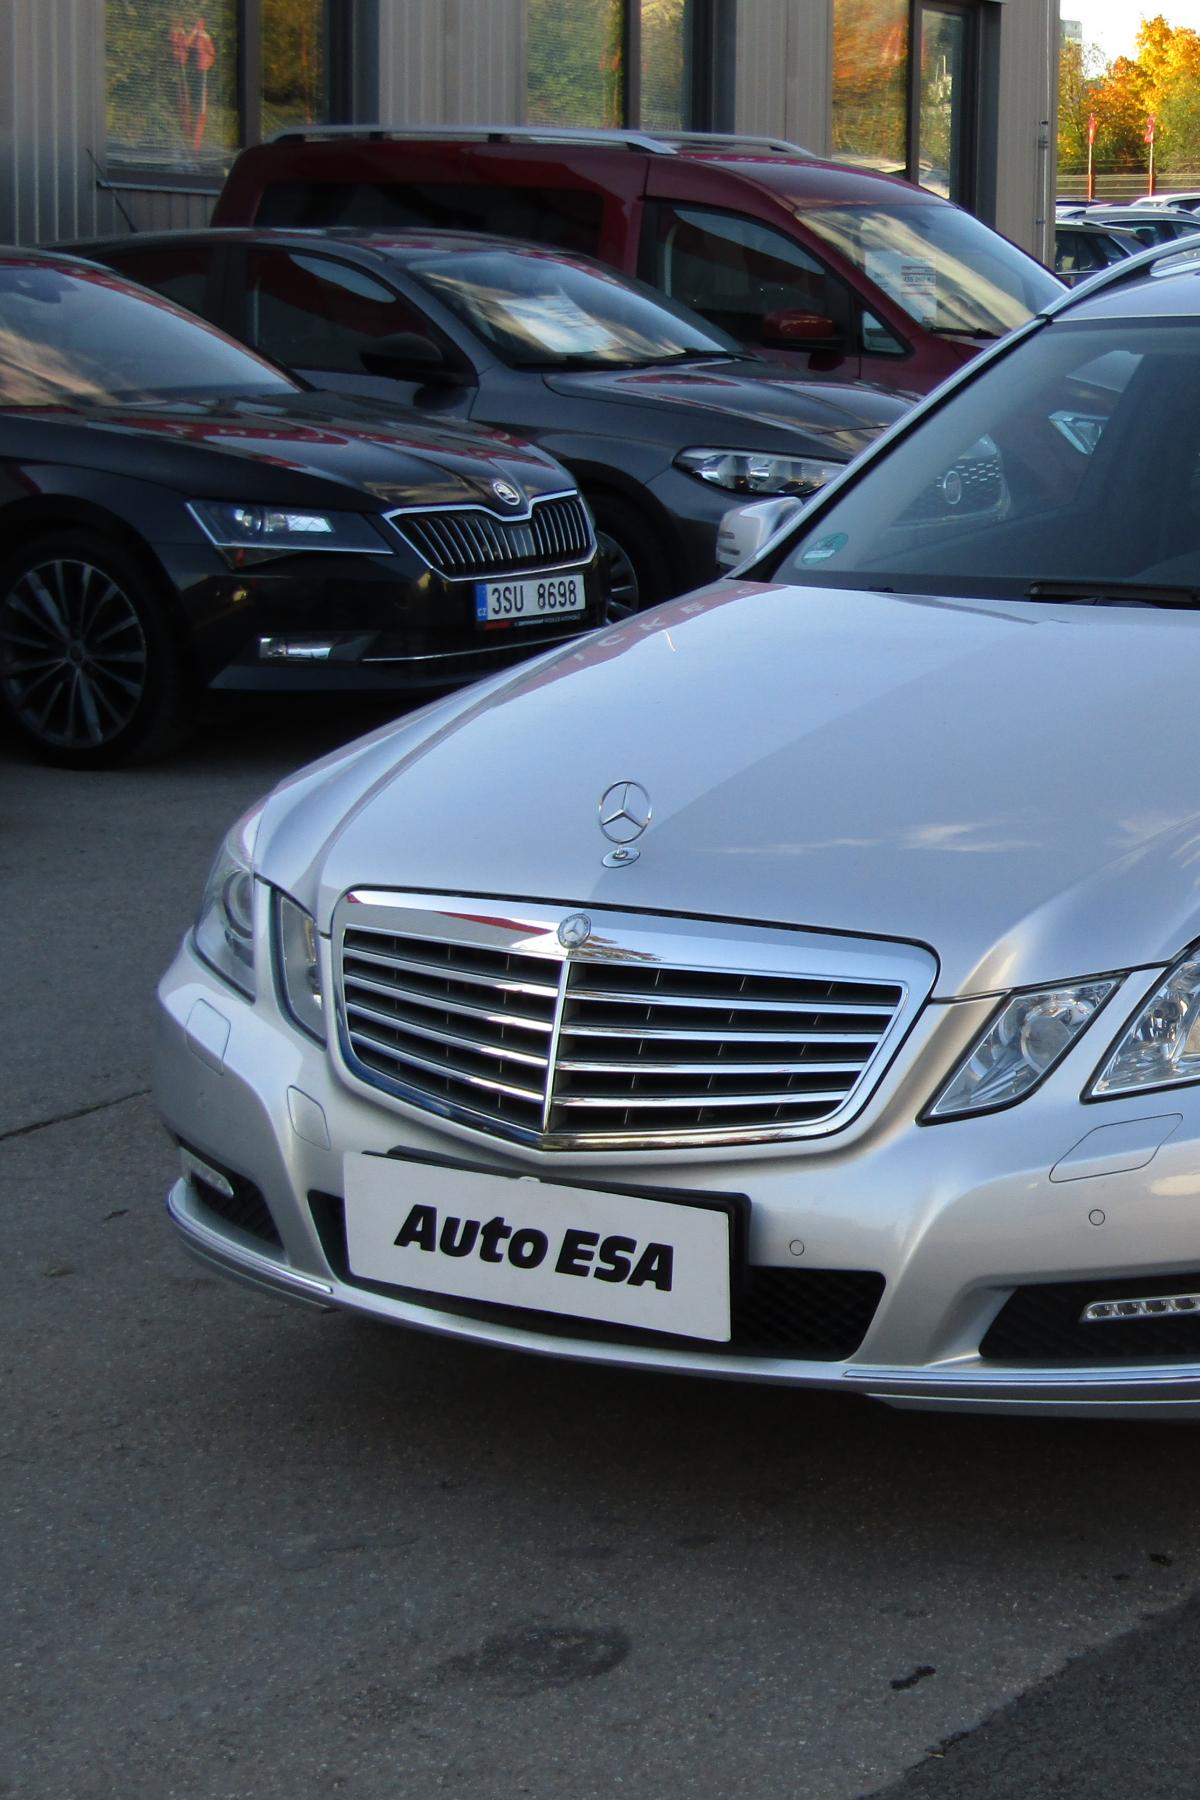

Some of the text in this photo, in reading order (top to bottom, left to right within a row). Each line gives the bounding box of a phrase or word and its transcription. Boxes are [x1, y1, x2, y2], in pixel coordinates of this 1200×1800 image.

[491, 579, 577, 615] 3SU 8698
[393, 1204, 674, 1292] Auto ESA
